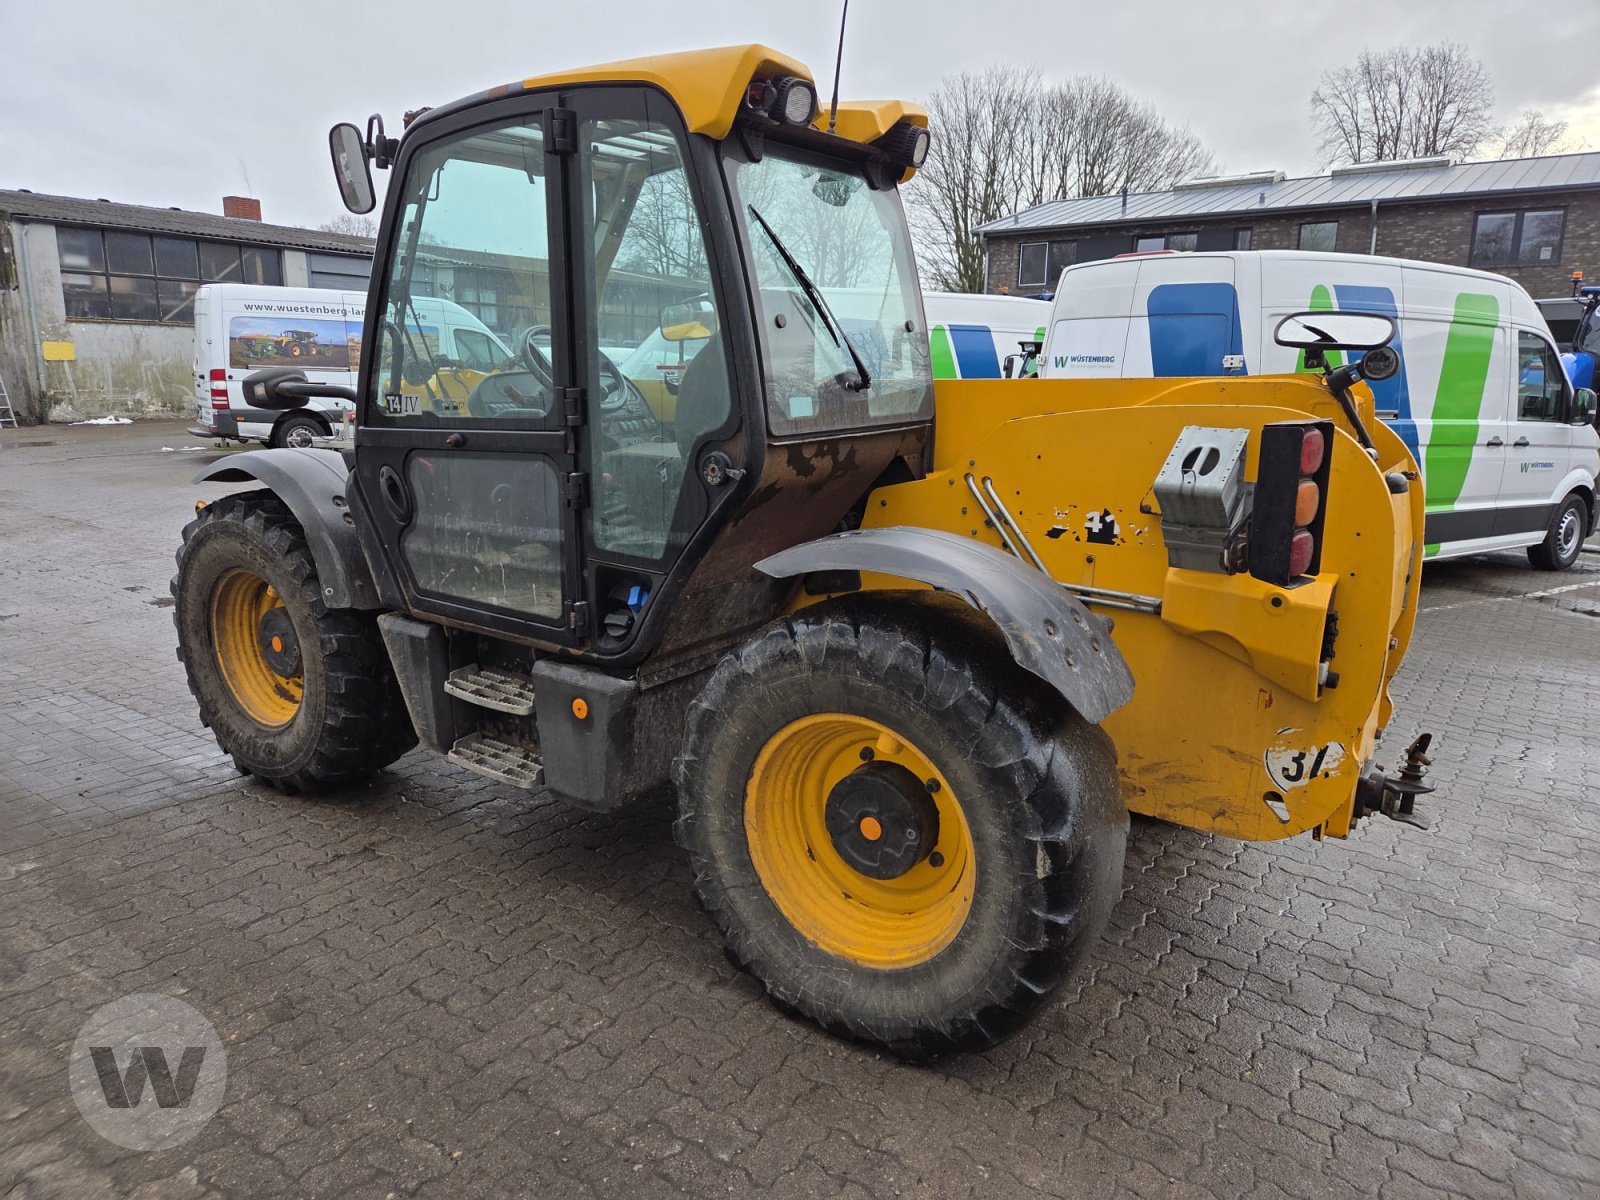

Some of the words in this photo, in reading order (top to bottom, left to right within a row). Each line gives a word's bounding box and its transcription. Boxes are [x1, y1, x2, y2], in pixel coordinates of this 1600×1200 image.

[1071, 354, 1116, 363] WÜSTENBERG
[386, 395, 401, 413] T4
[404, 396, 420, 413] IV
